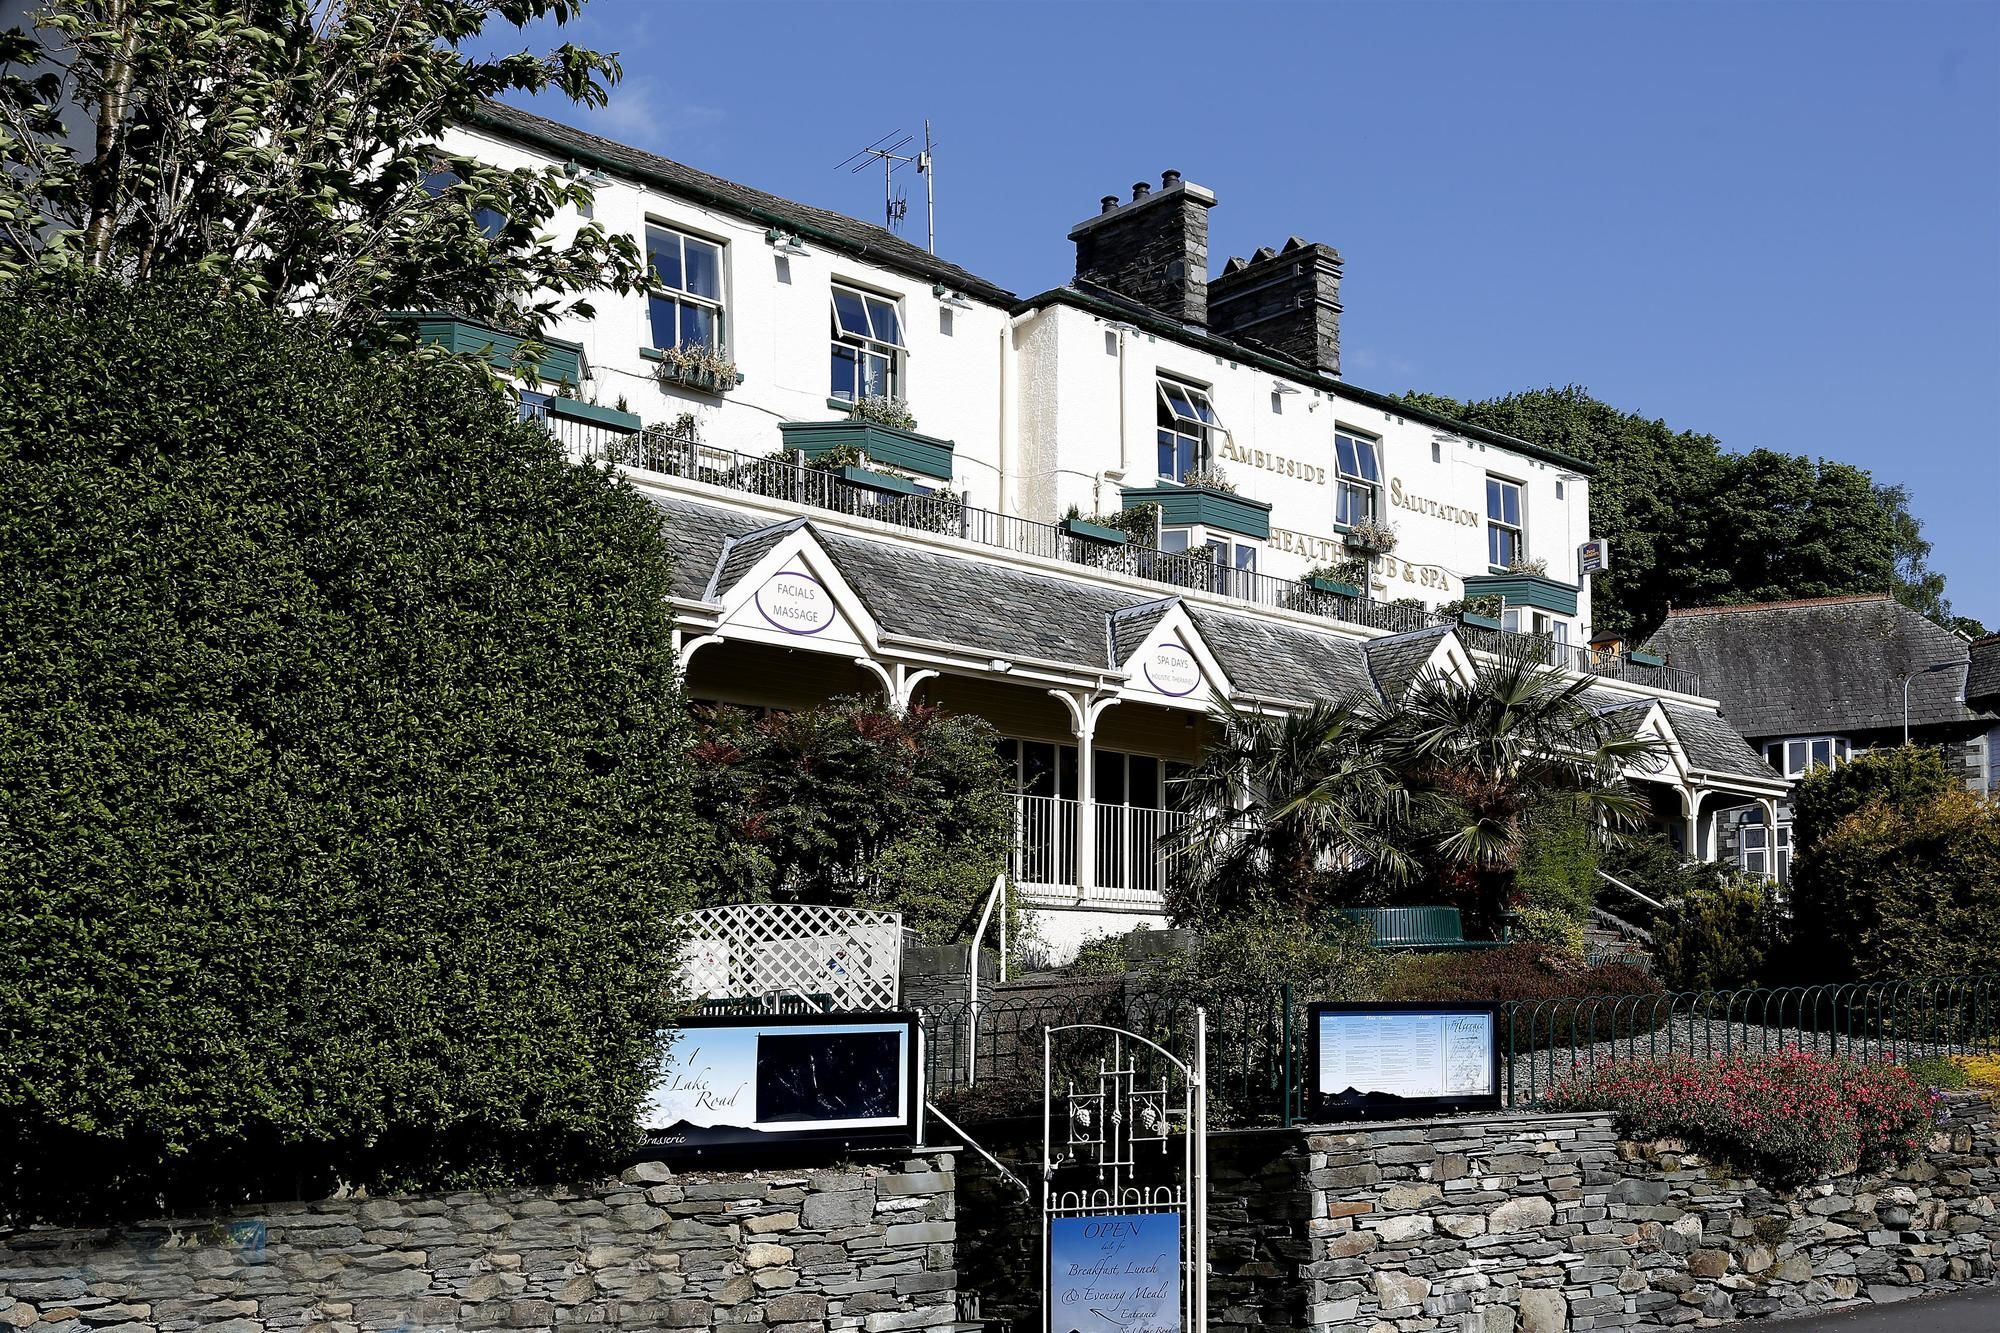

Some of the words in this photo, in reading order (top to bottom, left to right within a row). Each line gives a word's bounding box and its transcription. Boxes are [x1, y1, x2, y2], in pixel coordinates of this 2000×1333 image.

[1267, 527, 1345, 564] HEALTH
[1402, 562, 1417, 583] &
[1420, 566, 1450, 591] SPA
[777, 583, 815, 600] FACIALS
[773, 605, 819, 623] MASSAGE
[1157, 655, 1170, 665] SPA
[1171, 657, 1188, 669] DAYS
[670, 1067, 712, 1092] Lake
[695, 1082, 748, 1111] Road
[637, 1133, 687, 1146] Brasserie
[1084, 1219, 1147, 1239] OPEN
[1068, 1256, 1120, 1288] Breakfast,
[1124, 1254, 1166, 1275] Lunch
[1061, 1287, 1080, 1306] &
[1083, 1287, 1126, 1312] Evening
[1128, 1281, 1168, 1300] Meals
[1120, 1308, 1158, 1319] Entrance
